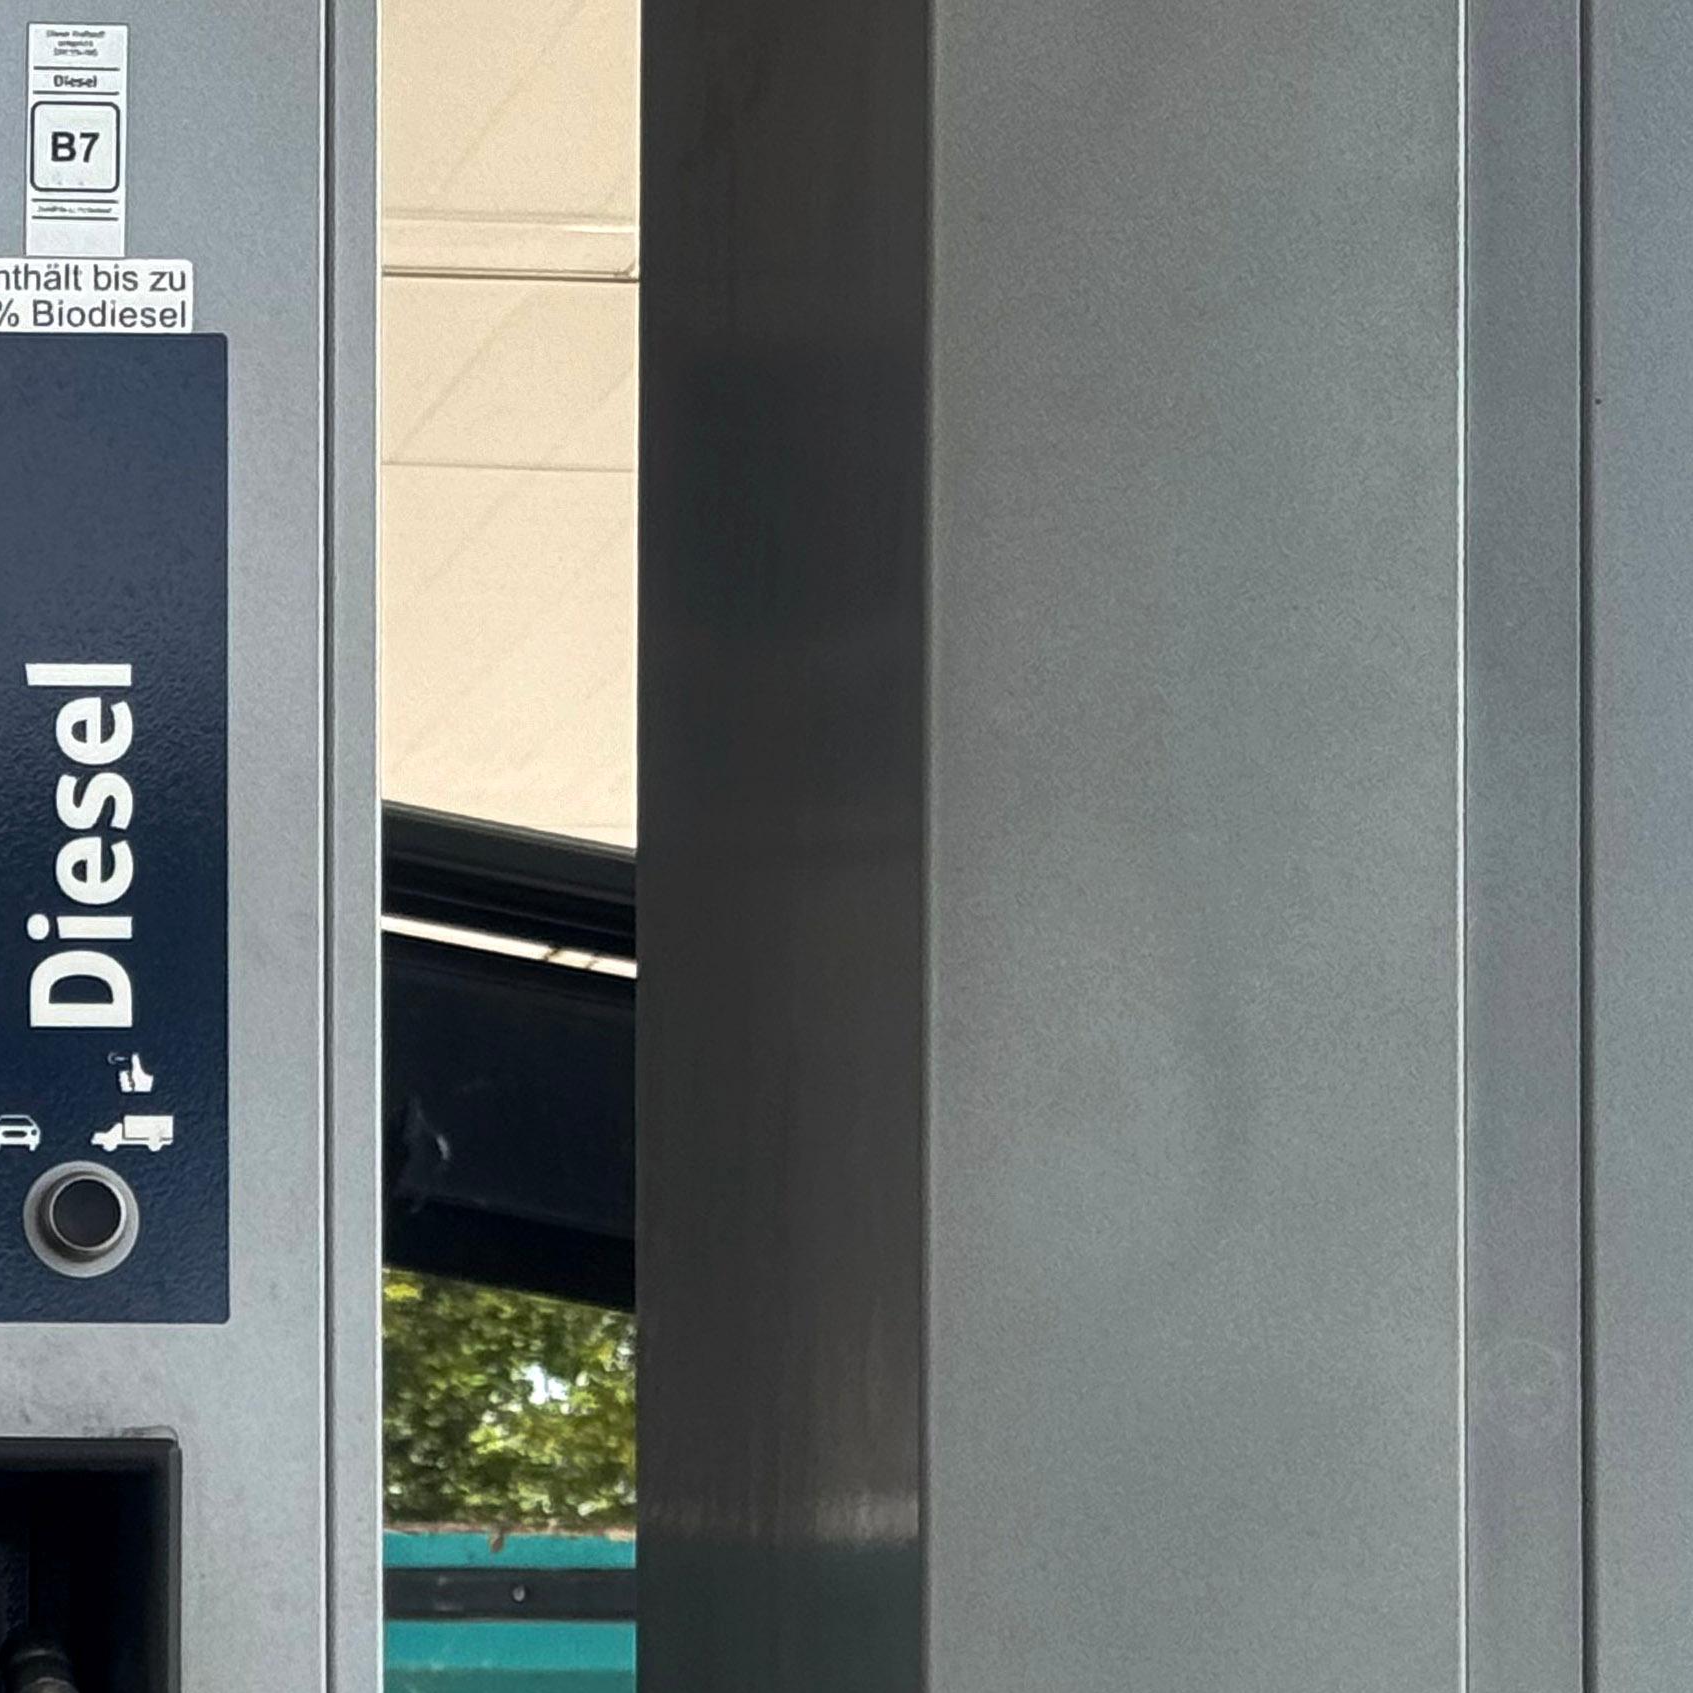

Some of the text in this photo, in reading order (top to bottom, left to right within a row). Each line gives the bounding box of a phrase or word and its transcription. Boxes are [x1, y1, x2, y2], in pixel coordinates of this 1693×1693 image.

[54, 75, 97, 88] Diesel
[50, 131, 100, 163] B7
[93, 263, 139, 292] bis
[149, 269, 187, 292] zu
[32, 298, 187, 329] Biodiesel
[25, 662, 134, 1029] Diesel
